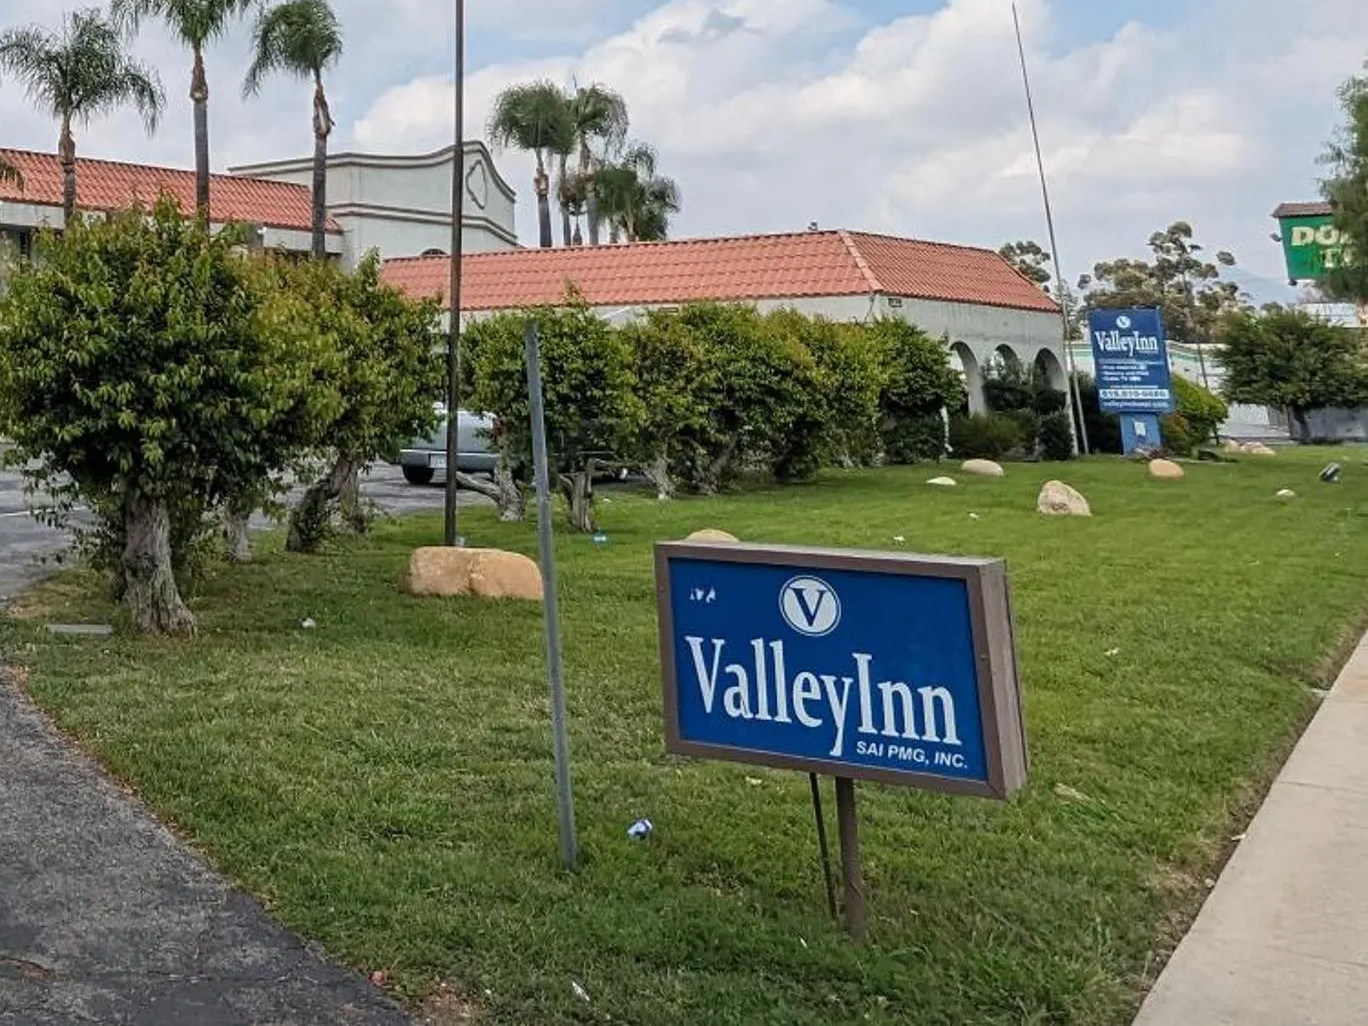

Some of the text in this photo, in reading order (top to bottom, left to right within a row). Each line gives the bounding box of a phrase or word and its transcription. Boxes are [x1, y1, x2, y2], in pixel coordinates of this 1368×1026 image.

[1094, 330, 1158, 357] ValleyInn
[789, 587, 827, 627] V
[685, 635, 962, 756] ValleyInn
[856, 741, 968, 768] SAI PMG, INC.
